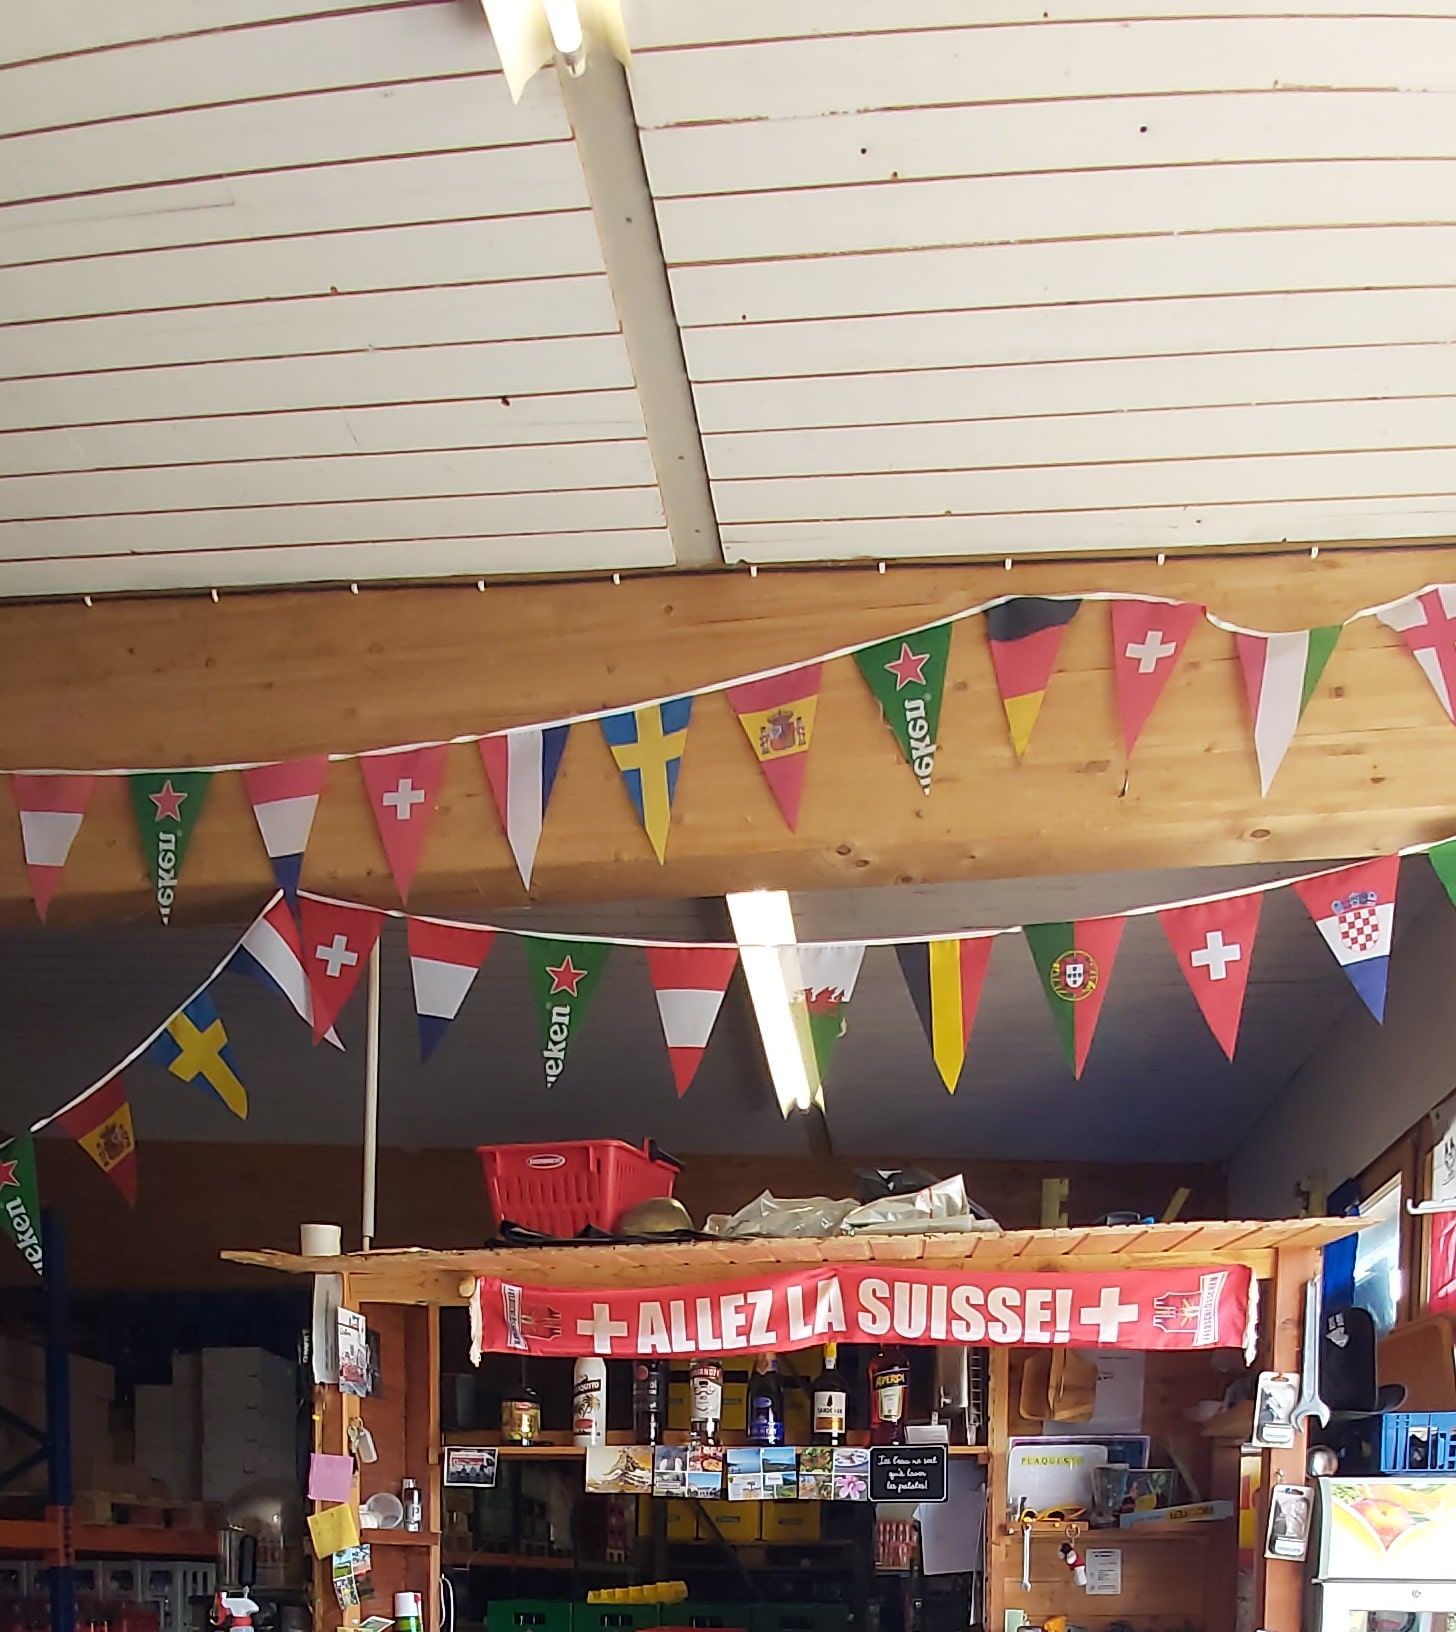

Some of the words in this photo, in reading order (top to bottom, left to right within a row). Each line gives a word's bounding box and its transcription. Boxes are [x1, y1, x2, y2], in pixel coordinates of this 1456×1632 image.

[637, 1289, 778, 1355] ALLEZ
[786, 1277, 848, 1342] LA
[857, 1278, 1073, 1344] SUISSE!
